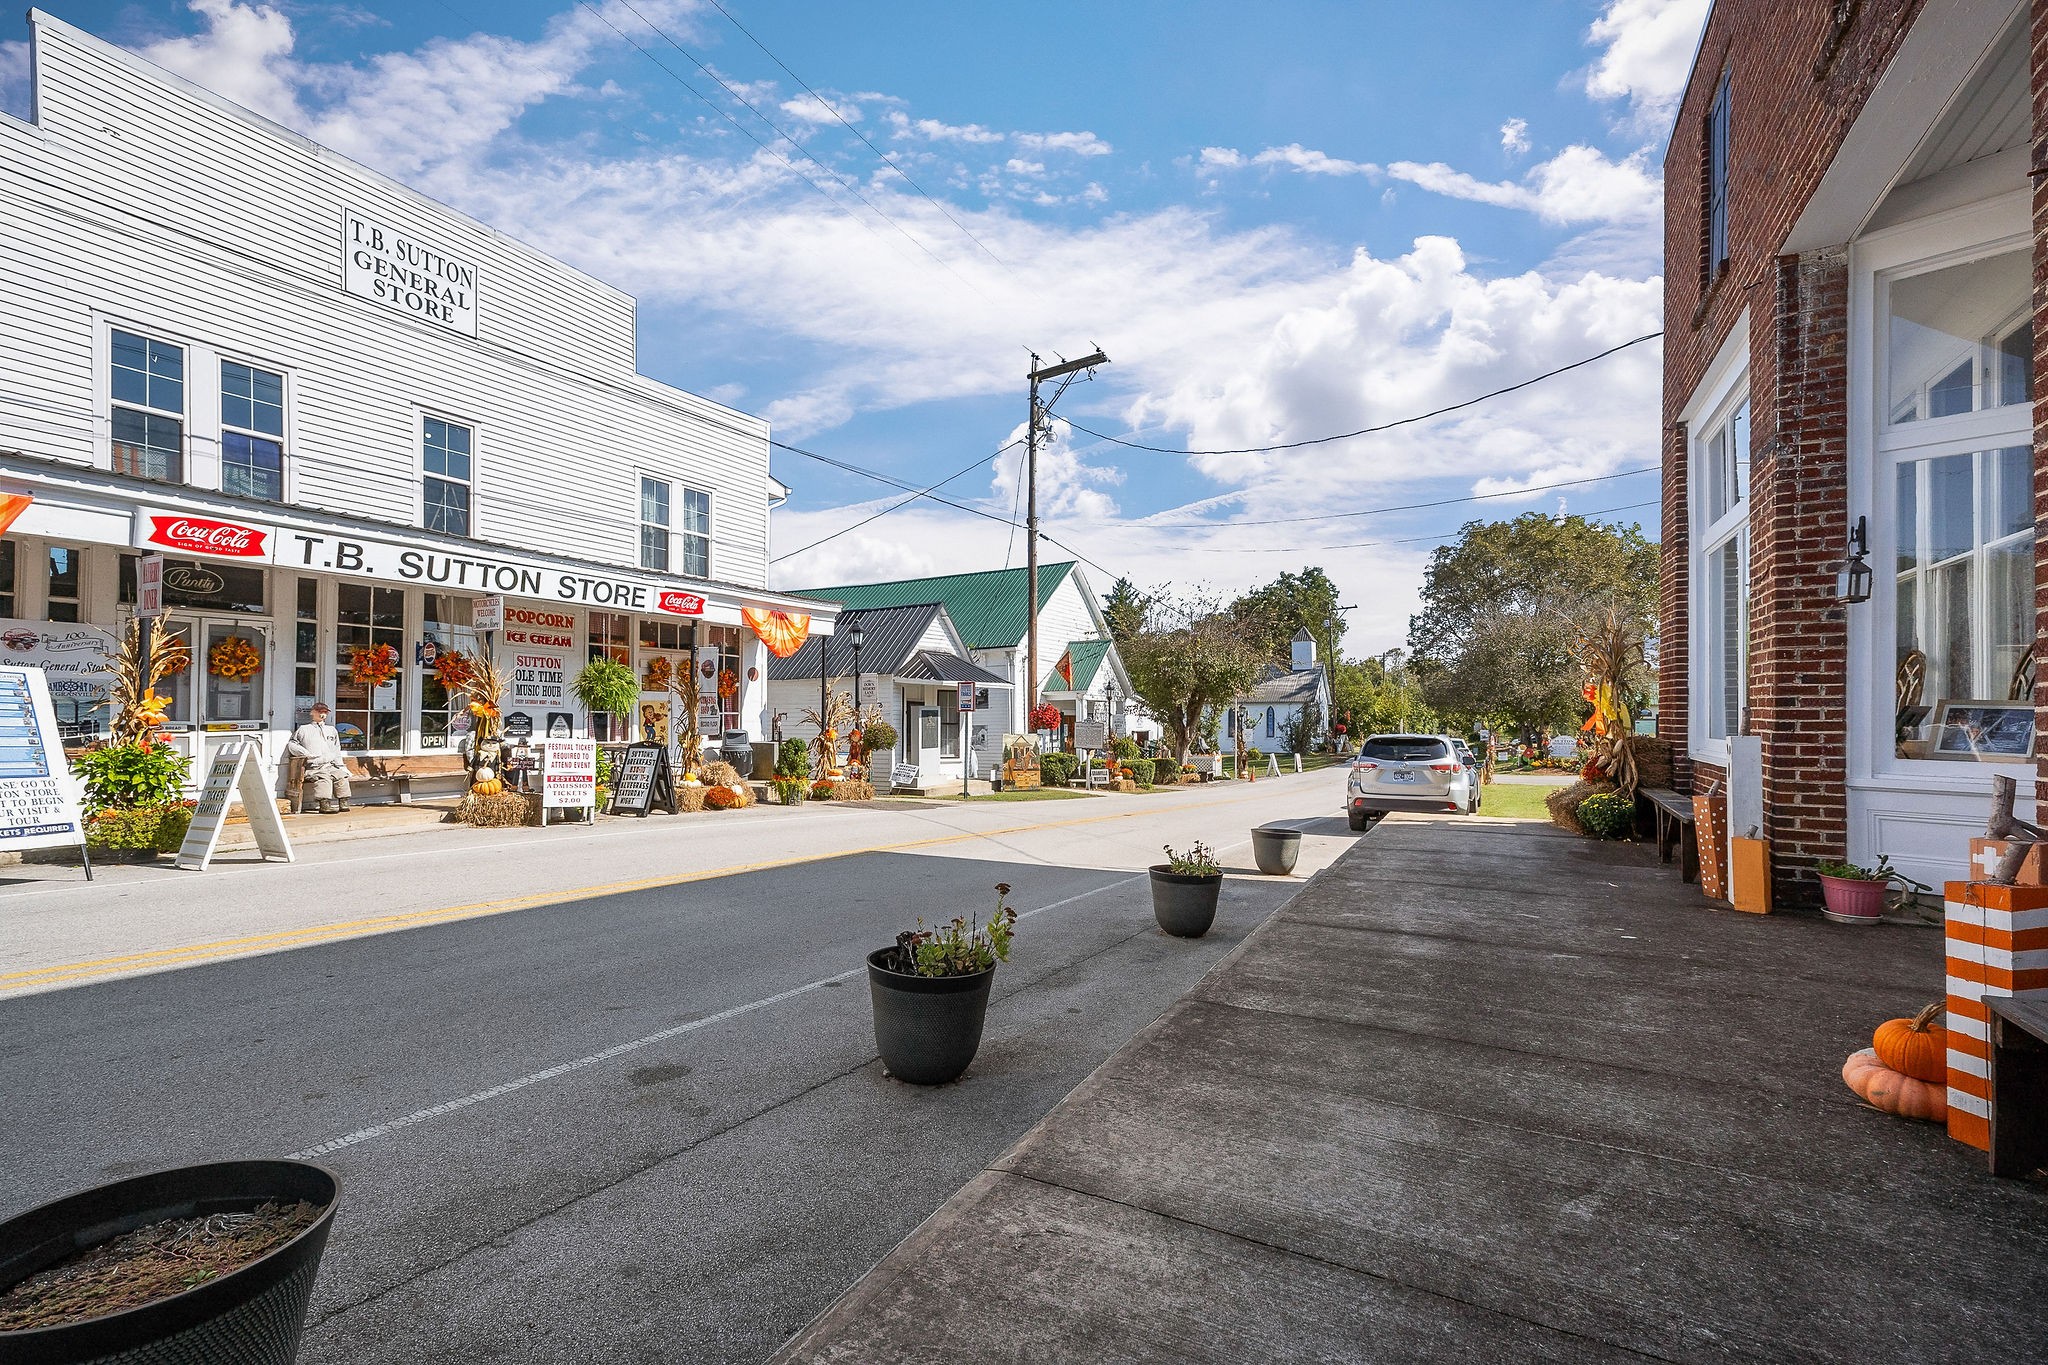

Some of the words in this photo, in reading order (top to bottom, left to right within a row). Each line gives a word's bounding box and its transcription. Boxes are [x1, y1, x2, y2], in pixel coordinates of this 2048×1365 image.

[350, 218, 389, 254] T.B.
[396, 239, 473, 290] SUTTON
[354, 250, 470, 310] GENERAL
[374, 278, 454, 323] STORE
[295, 534, 373, 572] T.B.
[399, 551, 542, 594] SUTTON
[558, 575, 646, 608] STORE
[169, 569, 216, 591] Purity
[478, 609, 496, 617] WELCOME
[505, 608, 574, 628] POPCORN
[506, 630, 527, 643] ICE
[530, 633, 572, 647] CREAM
[53, 641, 99, 650] Anniversary
[40, 660, 80, 674] General
[517, 655, 561, 669] SUTTON
[515, 669, 534, 681] OLE
[538, 671, 562, 683] TIME
[516, 684, 540, 696] MUSIC
[542, 686, 562, 697] HOUR
[423, 735, 445, 746] OPEN
[21, 780, 38, 789] GO
[24, 789, 60, 797] STORE
[31, 797, 64, 806] BEGIN
[18, 807, 50, 816] VISIT
[8, 816, 40, 826] TOUR
[23, 825, 70, 835] REQUIRED
